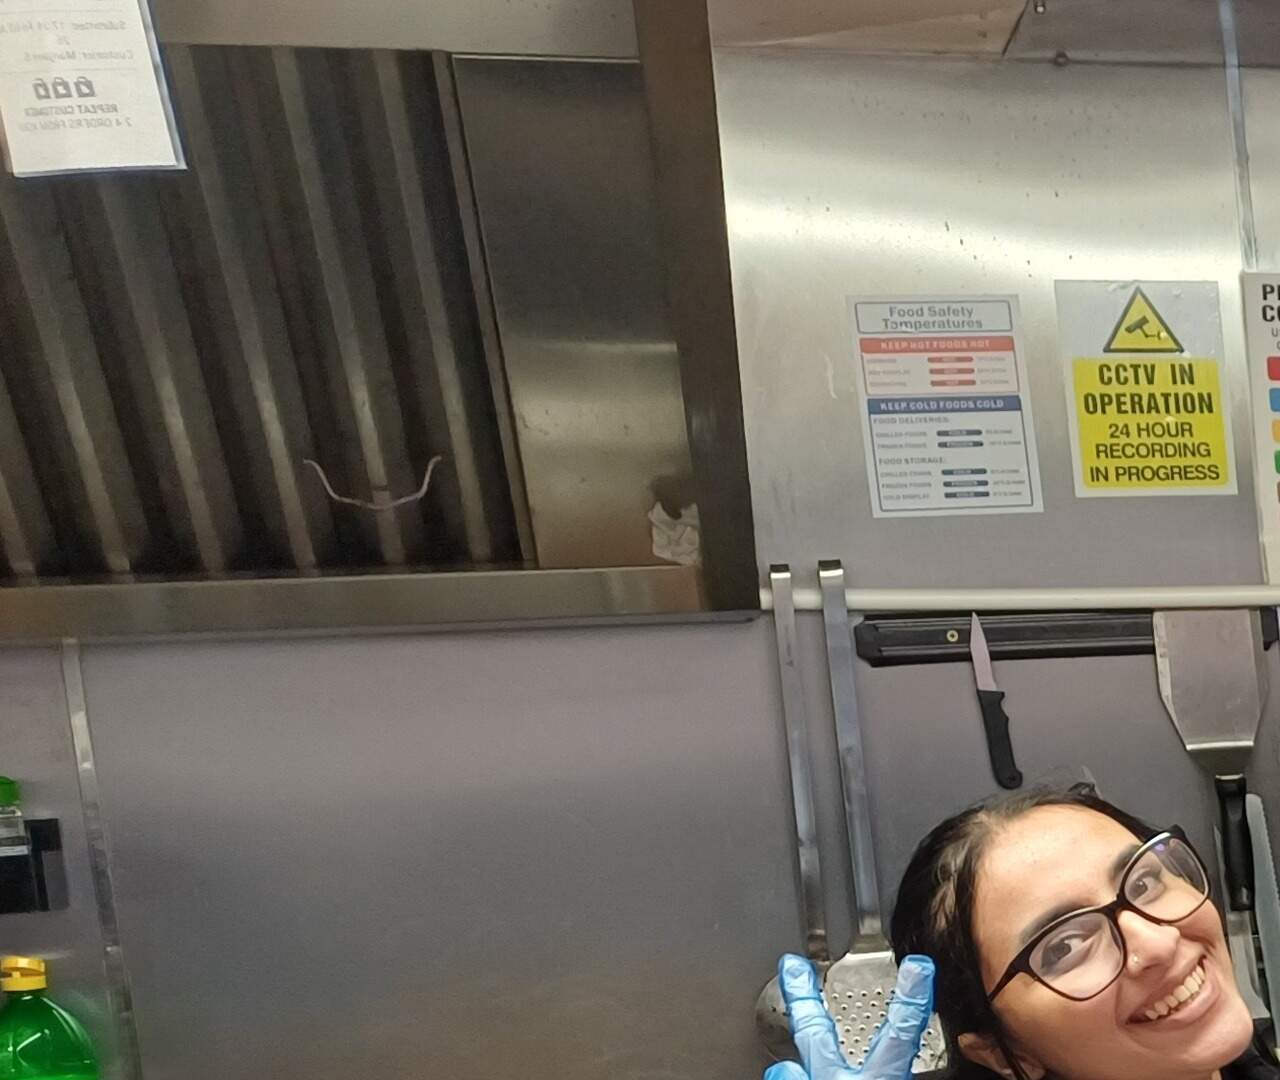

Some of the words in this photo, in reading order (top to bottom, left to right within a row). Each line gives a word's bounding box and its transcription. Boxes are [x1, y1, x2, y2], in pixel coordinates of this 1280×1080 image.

[889, 306, 924, 318] Food
[928, 305, 974, 319] Safety
[882, 318, 983, 331] Temperatures
[1098, 363, 1156, 386] CCTV
[1170, 363, 1195, 385] IN
[880, 402, 909, 411] KEEP
[910, 401, 937, 410] COLD
[939, 400, 975, 409] FOODS
[977, 400, 1004, 408] COLD
[1083, 392, 1214, 415] OPERATION
[1108, 423, 1130, 439] 24
[1136, 422, 1193, 438] HOUR
[1095, 442, 1211, 459] RECORDING
[1090, 466, 1109, 482] IN
[1115, 464, 1220, 482] PROGRESS
